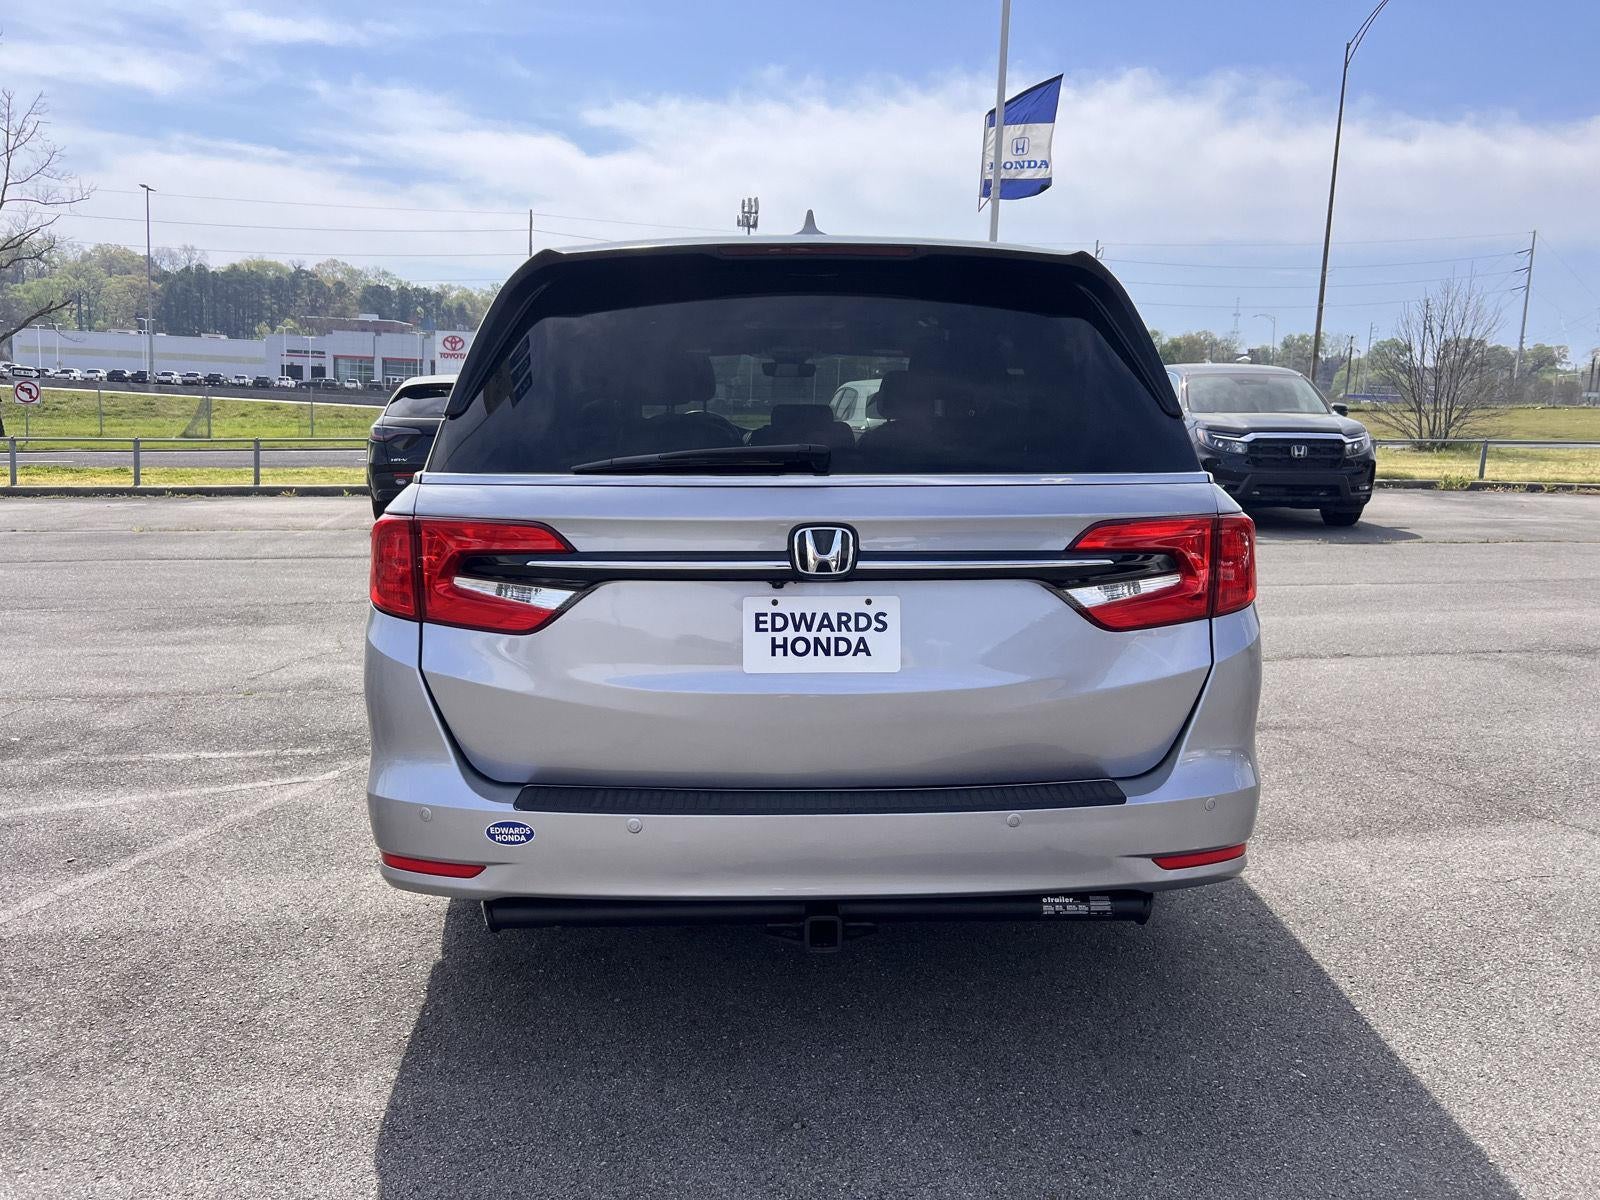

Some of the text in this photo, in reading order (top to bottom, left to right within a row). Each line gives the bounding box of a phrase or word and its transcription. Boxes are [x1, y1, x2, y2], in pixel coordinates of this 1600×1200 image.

[754, 612, 888, 633] EDWARDS
[770, 636, 872, 658] HONDA
[490, 827, 531, 835] EDWARDS
[495, 834, 527, 842] HONDA
